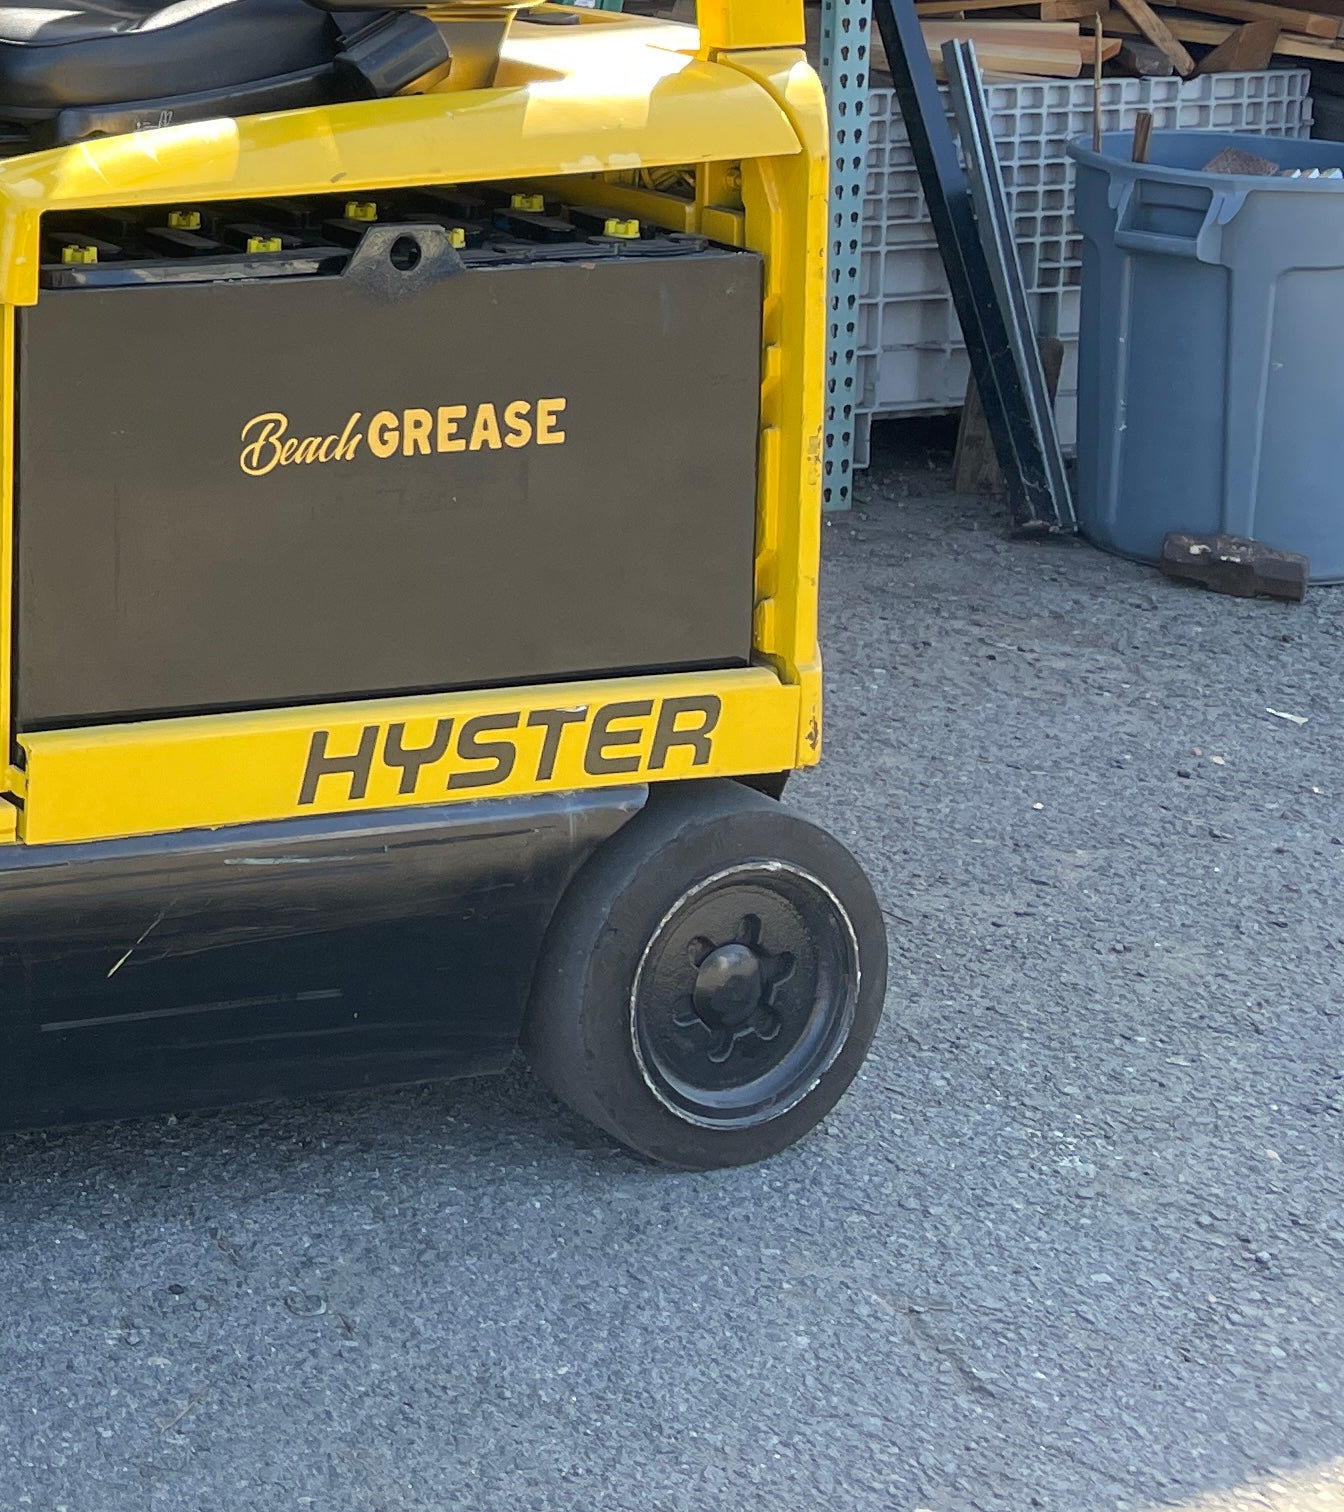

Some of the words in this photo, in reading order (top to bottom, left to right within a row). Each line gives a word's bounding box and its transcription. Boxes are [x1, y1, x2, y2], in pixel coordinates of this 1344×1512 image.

[240, 412, 362, 476] Beach
[367, 397, 567, 459] GREASE
[298, 695, 722, 806] HYSTER
